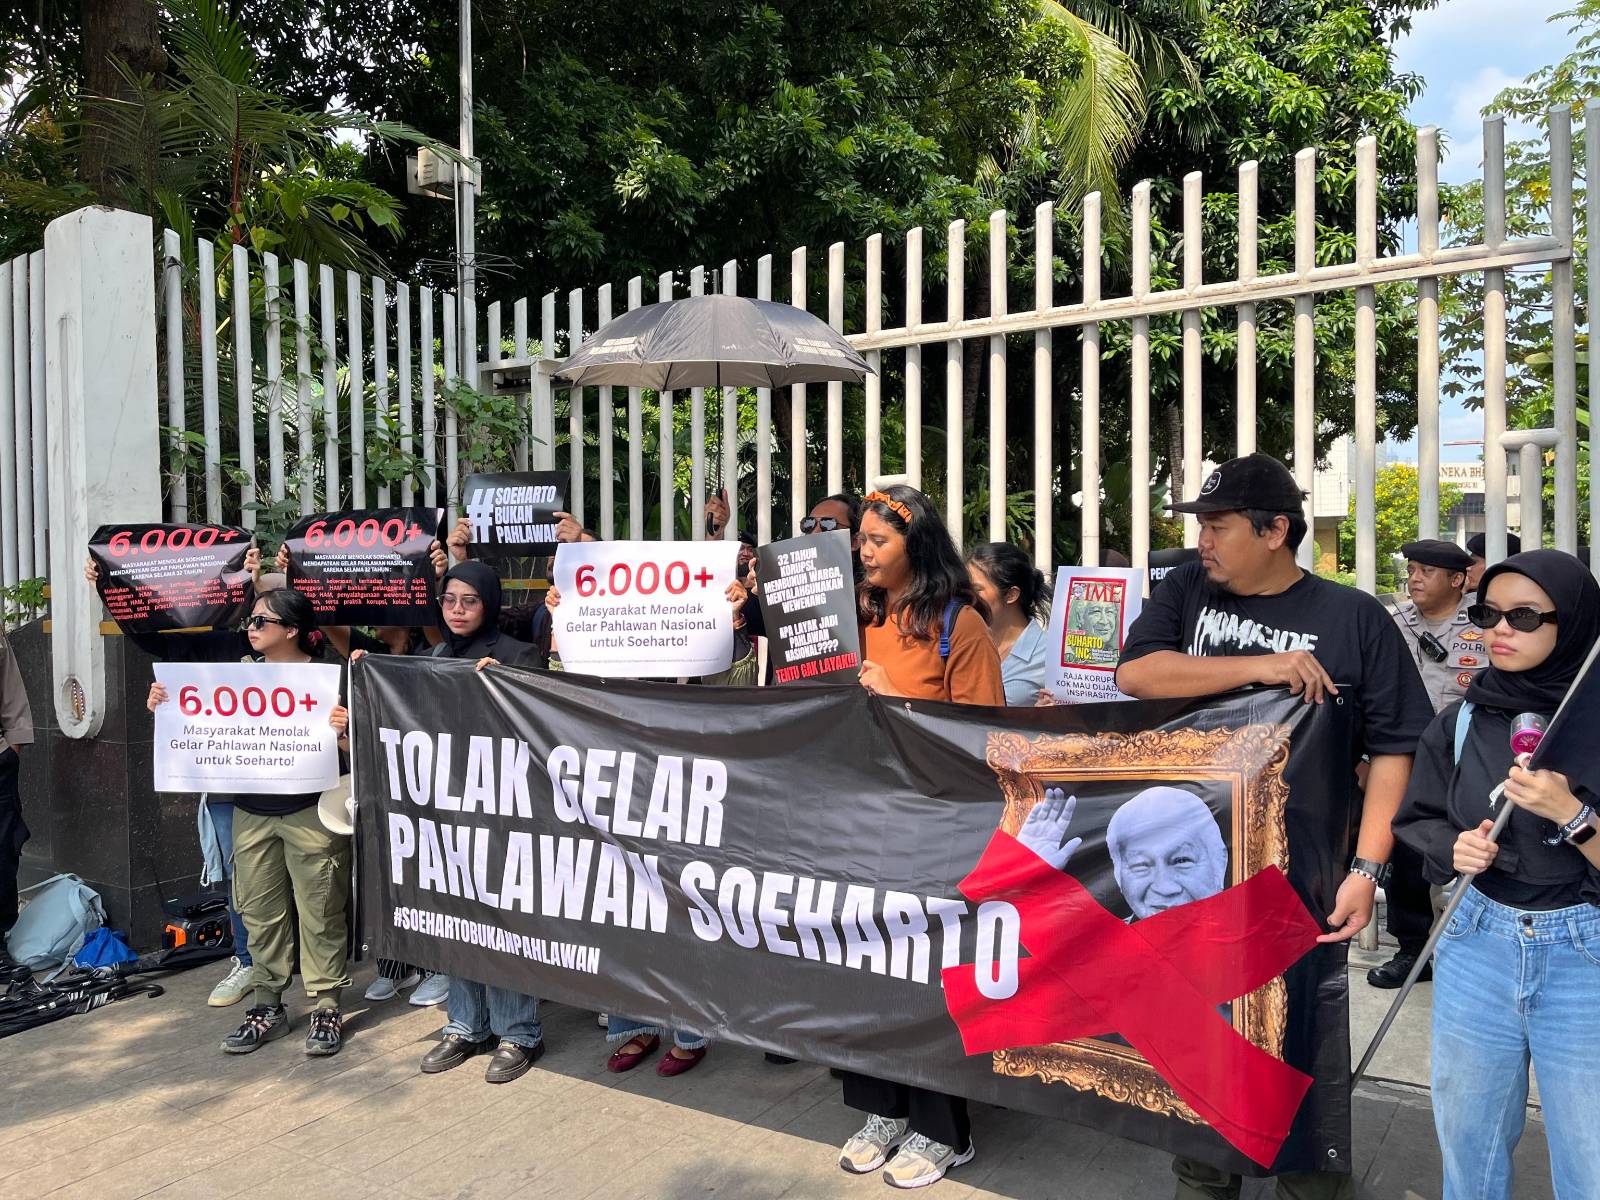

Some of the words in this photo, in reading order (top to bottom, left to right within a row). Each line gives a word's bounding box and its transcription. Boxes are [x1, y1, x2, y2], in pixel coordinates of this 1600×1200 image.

[495, 486, 556, 505] SOEHARTO
[467, 488, 495, 543] #
[495, 505, 532, 524] BUKAN
[108, 528, 240, 557] 6.000+
[304, 518, 422, 548] 6.000+
[778, 554, 789, 566] 32
[790, 547, 817, 563] TAHUN
[780, 560, 816, 577] KORUPSI,
[1150, 566, 1176, 580] PEM
[575, 561, 714, 597] 6.000+
[764, 573, 808, 594] MEMBUNUH
[809, 566, 843, 582] WARGA,
[766, 577, 843, 606] MENYALAHGUNAKAN
[579, 604, 646, 619] Masyarakat
[650, 603, 704, 615] Menolak
[782, 593, 826, 614] WEWENANG
[566, 622, 597, 632] Gelar
[601, 620, 657, 632] Pahlawan
[661, 618, 716, 630] Nasional
[779, 625, 794, 639] APA
[794, 619, 818, 635] LAYAK
[819, 614, 838, 629] JADI
[590, 636, 624, 648] untuk
[627, 635, 688, 647] Soeharto!
[789, 629, 830, 648] PAHLAWAN
[1067, 635, 1104, 649] SUHARTO
[785, 639, 839, 662] NASIONAL????
[1076, 647, 1092, 660] INC.
[776, 665, 800, 683] TENTU
[800, 660, 818, 678] GAK
[819, 652, 858, 674] LAYAK!!!
[179, 686, 318, 718] 6.000+
[1067, 689, 1117, 700] INSPIRASI???
[183, 724, 255, 740] Masyarakat
[259, 726, 310, 736] Menolak
[170, 740, 203, 750] Gelar
[208, 739, 266, 751] Pahlawan
[270, 741, 322, 752] Nasional
[196, 755, 231, 765] untuk
[235, 755, 294, 766] Soeharto!
[379, 728, 533, 819] TOLAK
[547, 744, 728, 847] GELAR
[388, 812, 668, 933] PAHLAWAN
[679, 861, 1021, 999] SOEHARTO
[394, 906, 600, 974] #SOEHARTOBUKANPAHLAWAN
